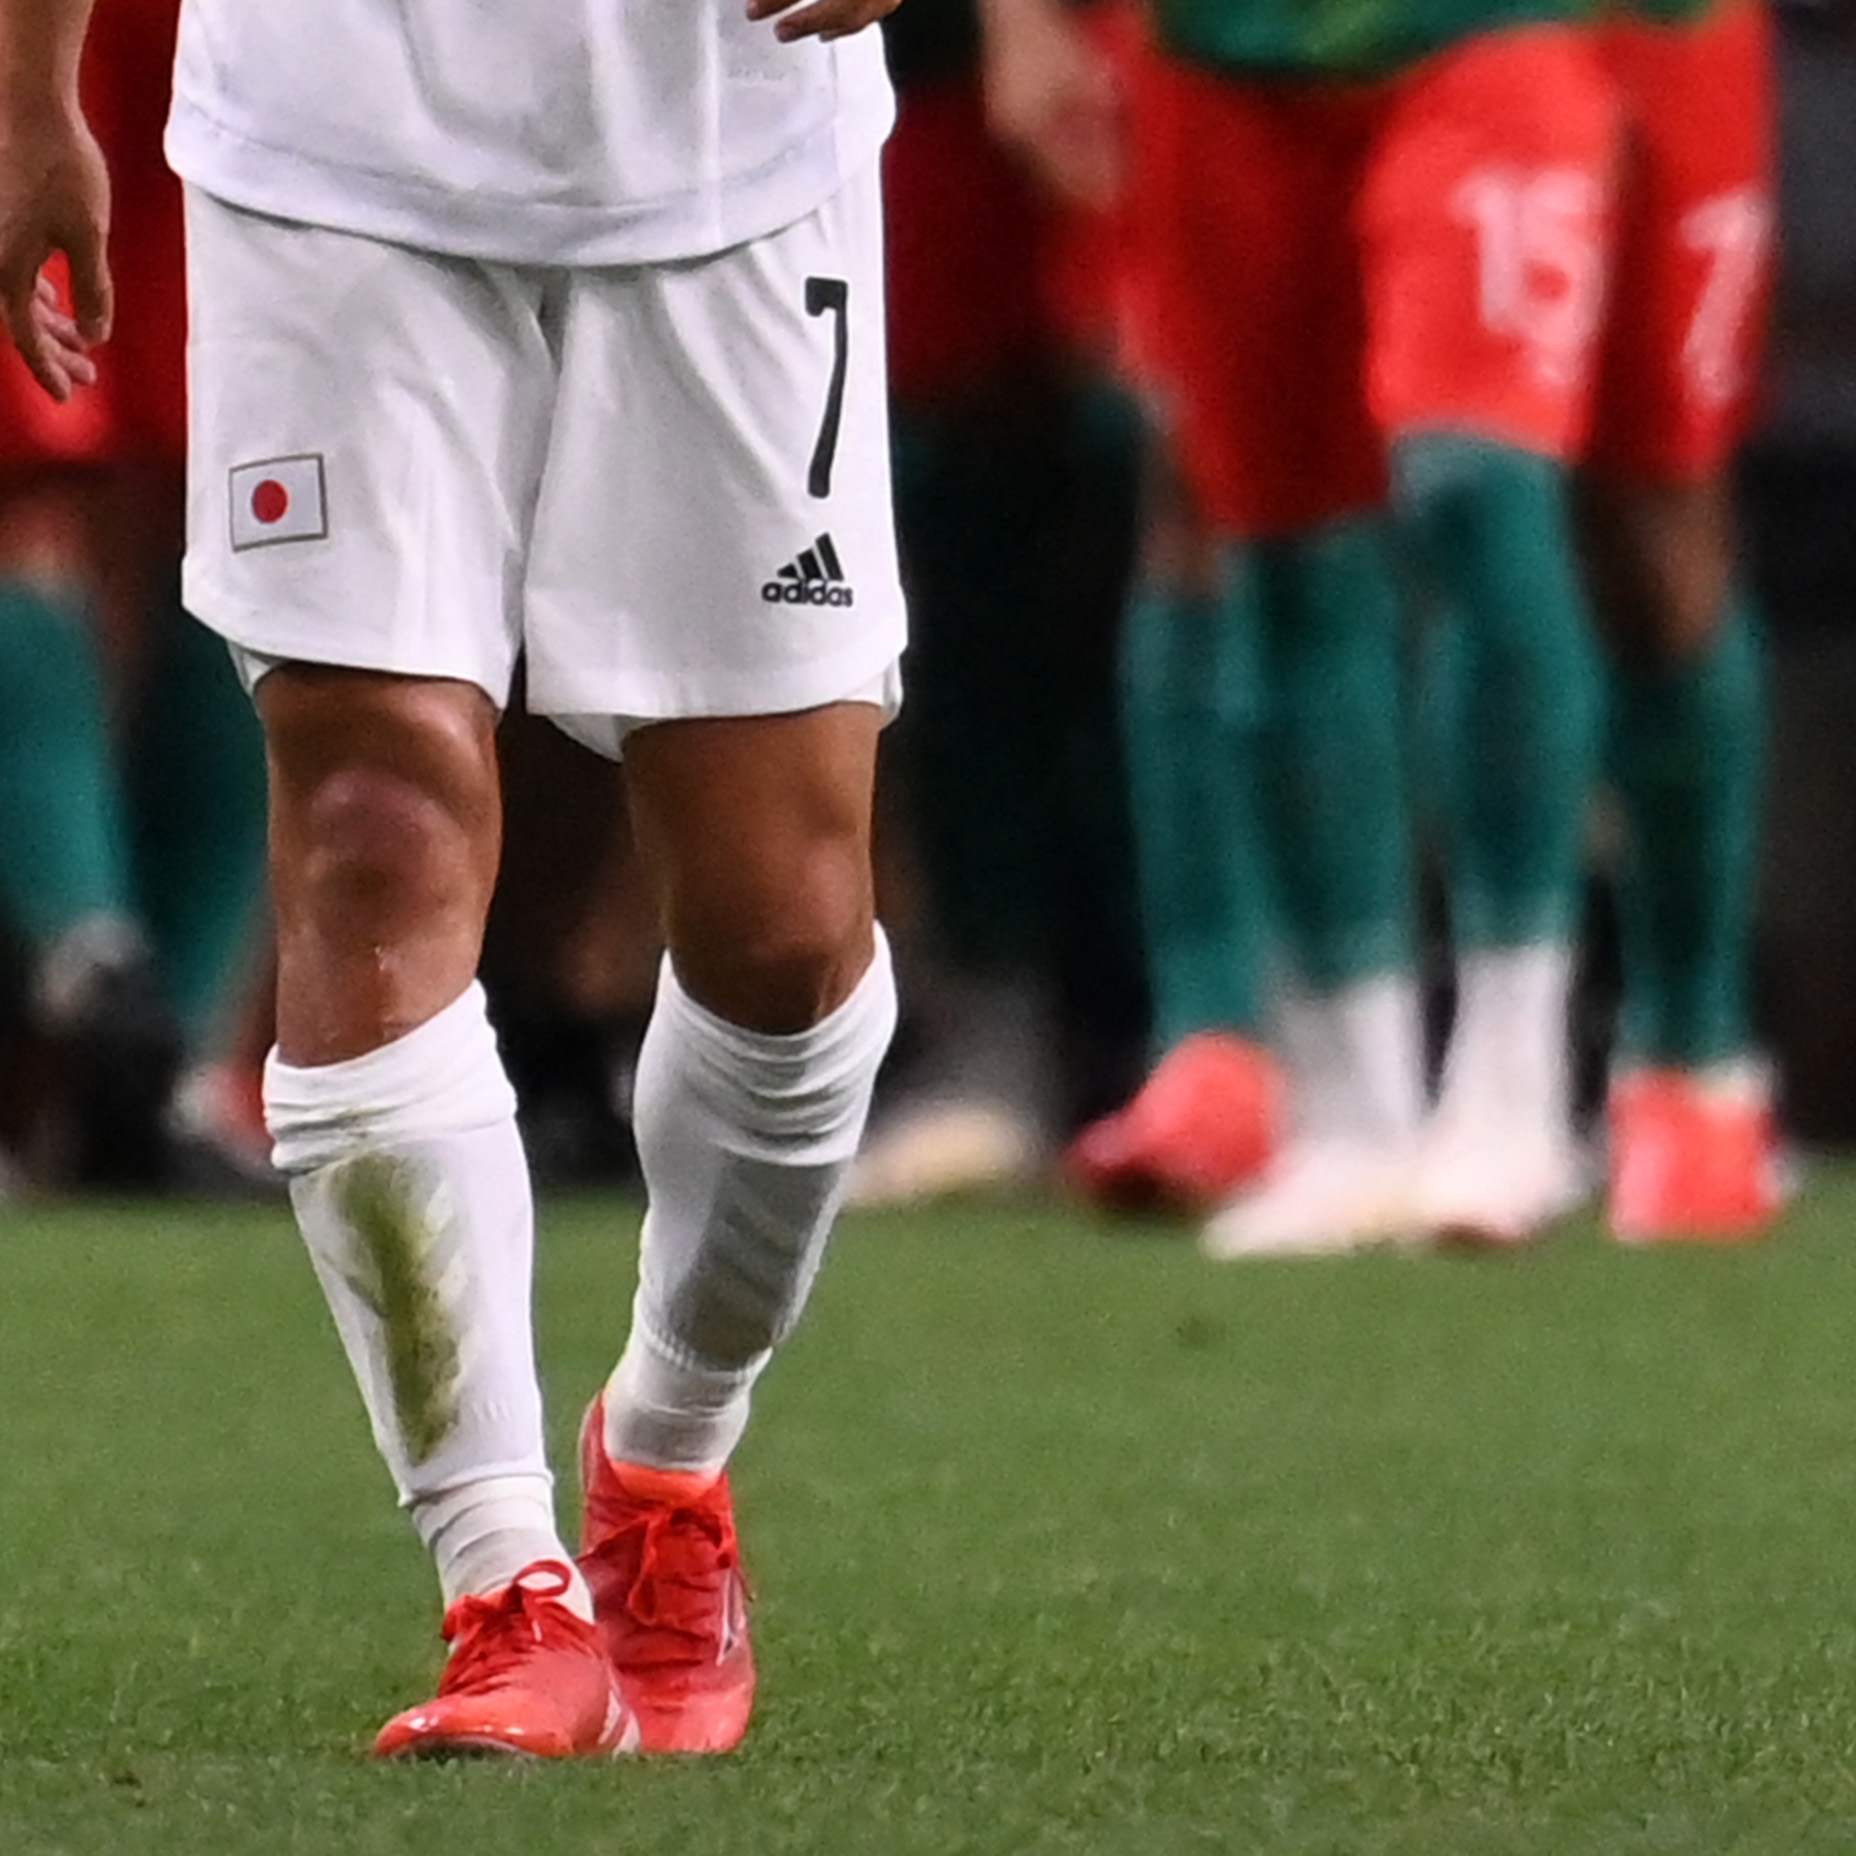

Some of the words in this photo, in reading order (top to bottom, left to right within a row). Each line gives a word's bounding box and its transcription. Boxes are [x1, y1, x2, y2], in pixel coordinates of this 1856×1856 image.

[1448, 161, 1608, 350] 15
[805, 275, 848, 499] 7
[761, 577, 853, 608] adidas
